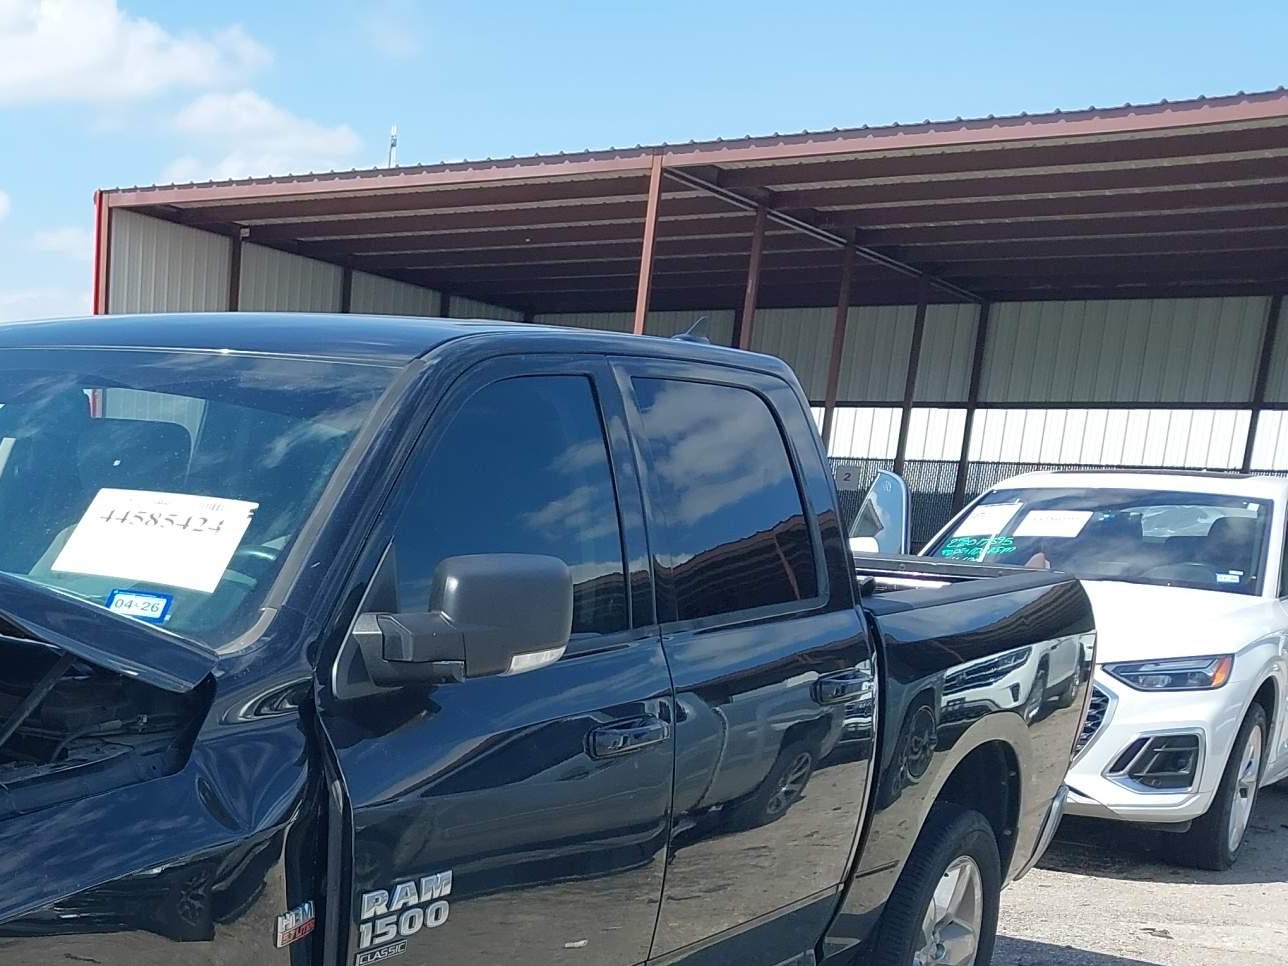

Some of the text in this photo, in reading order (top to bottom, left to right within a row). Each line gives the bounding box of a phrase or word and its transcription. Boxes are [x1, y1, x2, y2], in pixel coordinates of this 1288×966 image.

[842, 472, 852, 482] 2
[362, 870, 453, 920] RAM
[359, 900, 450, 949] 1500
[359, 942, 407, 965] CLASSIC
